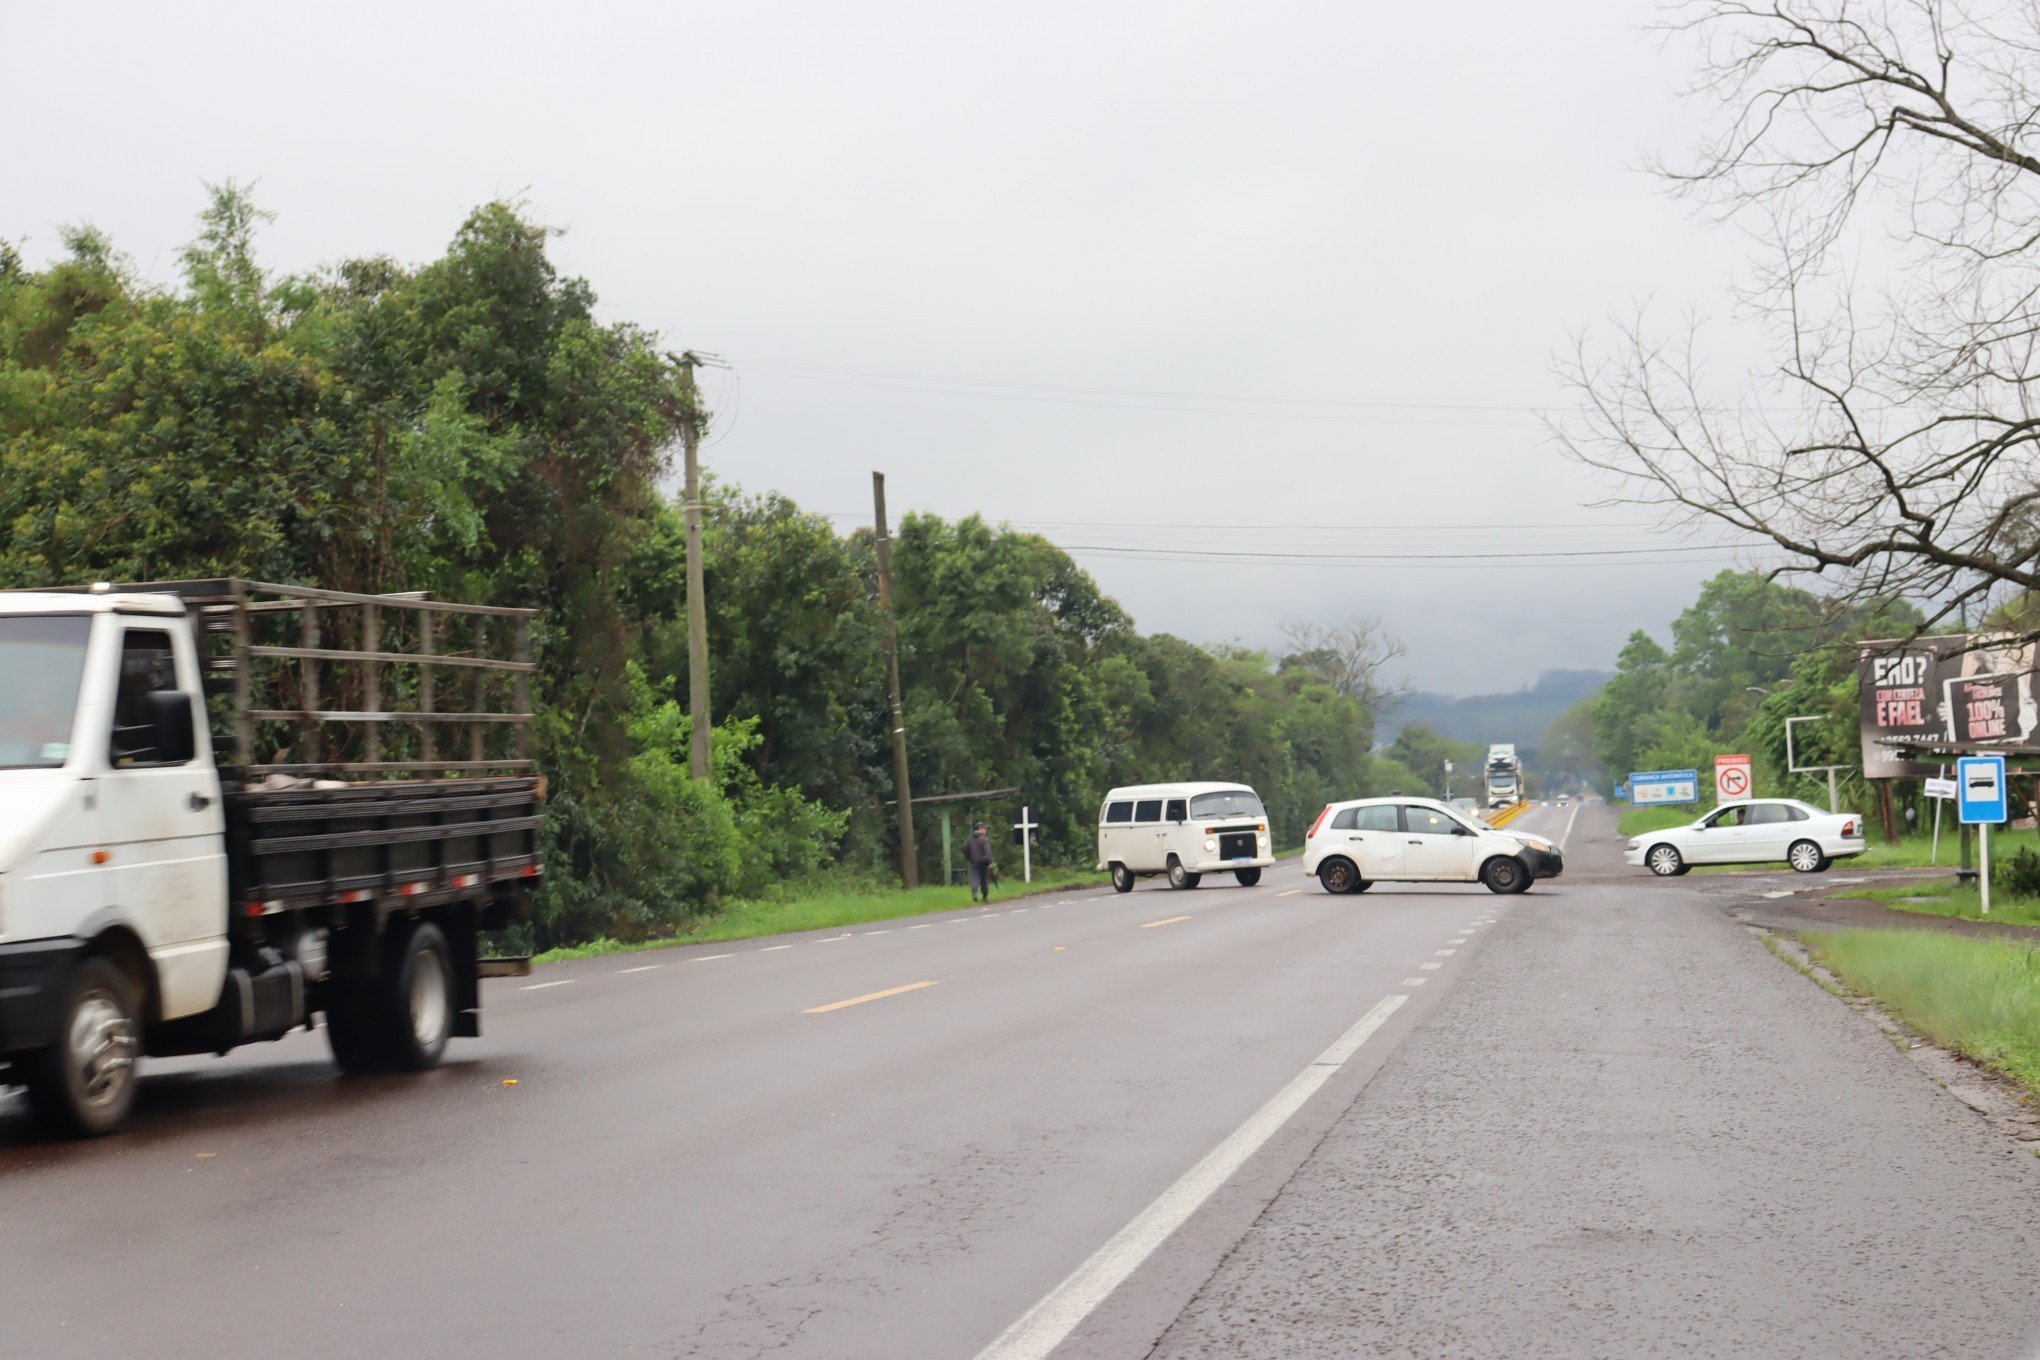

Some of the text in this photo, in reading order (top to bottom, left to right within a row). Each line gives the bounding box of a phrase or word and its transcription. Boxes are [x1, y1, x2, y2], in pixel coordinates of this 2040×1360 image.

[1874, 656, 1927, 686] EAD?
[1888, 701, 1925, 726] FAEL
[1966, 699, 2005, 721] 100%
[1968, 718, 2006, 738] ONLINE
